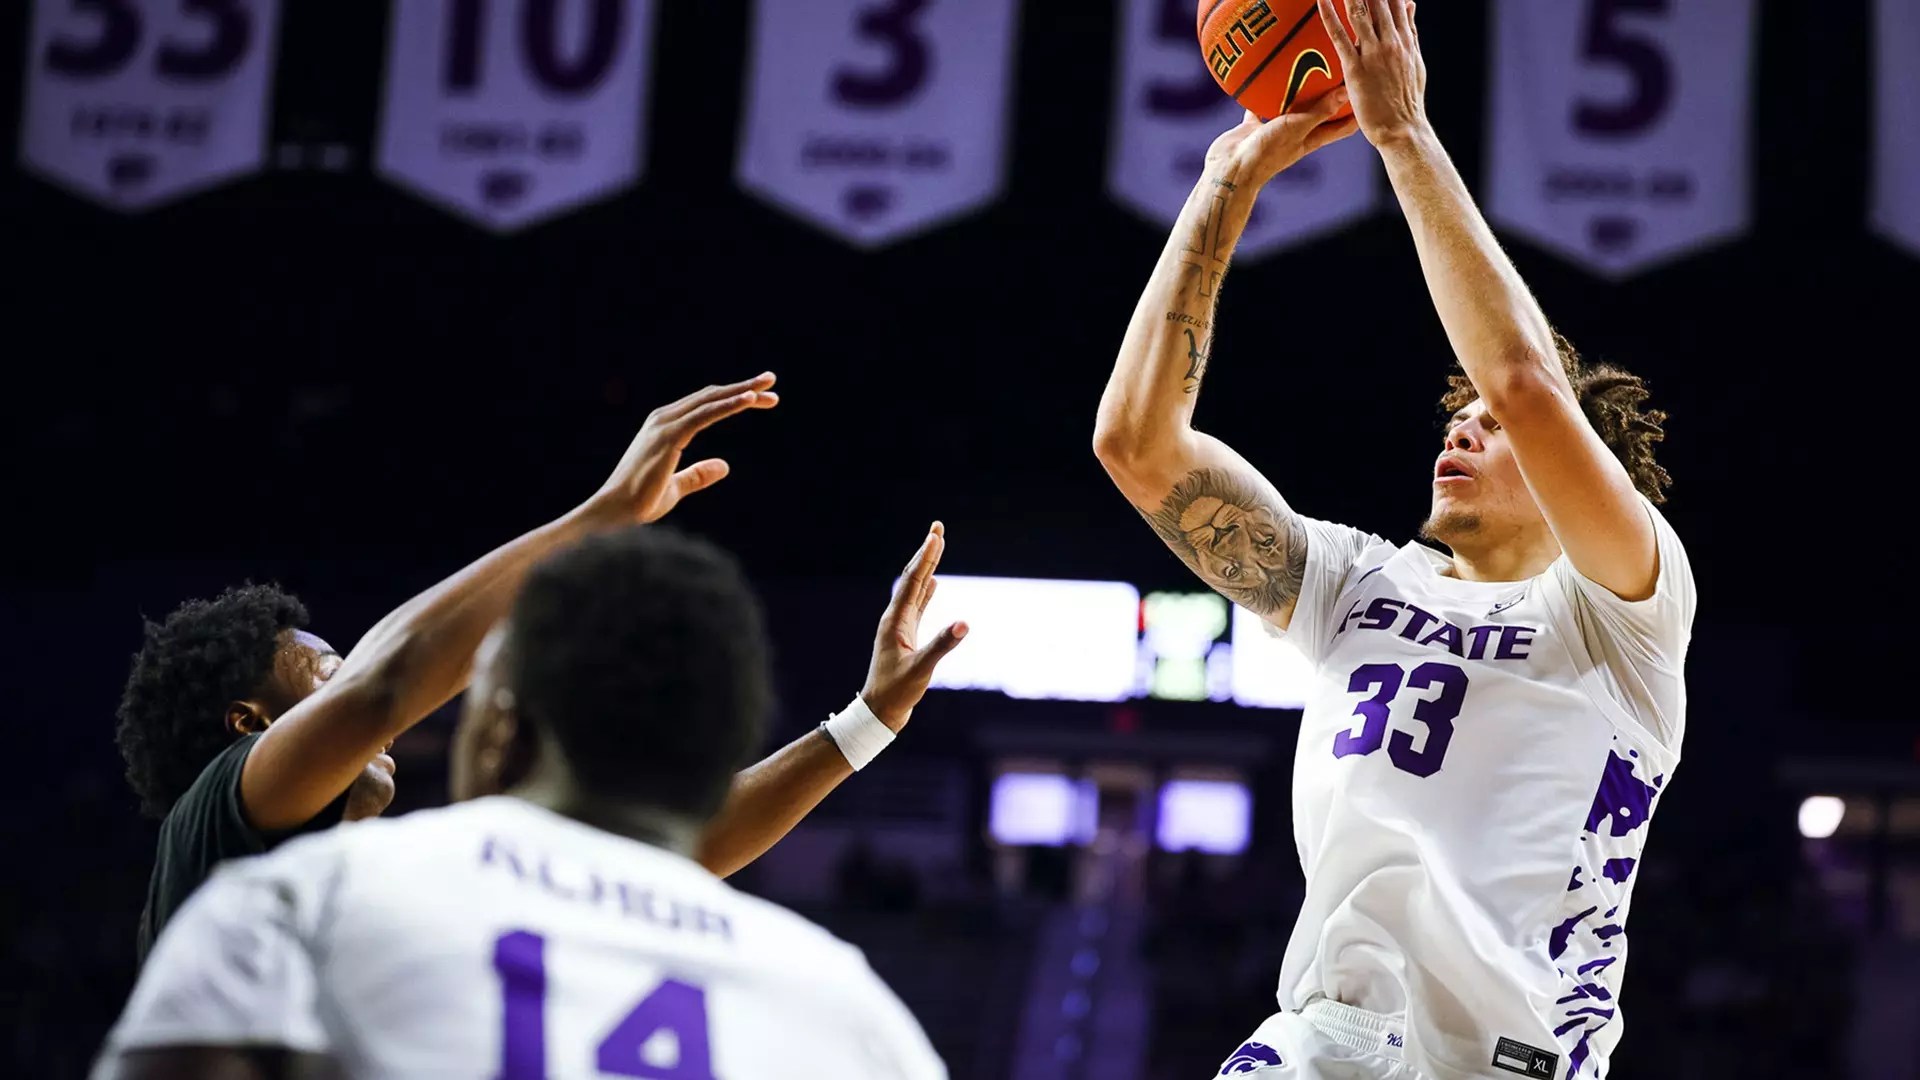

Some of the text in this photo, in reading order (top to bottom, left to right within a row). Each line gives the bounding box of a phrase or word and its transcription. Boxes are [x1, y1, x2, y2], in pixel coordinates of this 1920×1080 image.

[1208, 0, 1279, 82] ELITE
[1570, 0, 1677, 139] 5
[1332, 661, 1469, 778] 33
[492, 930, 716, 1080] 14
[1533, 1057, 1549, 1074] XL
